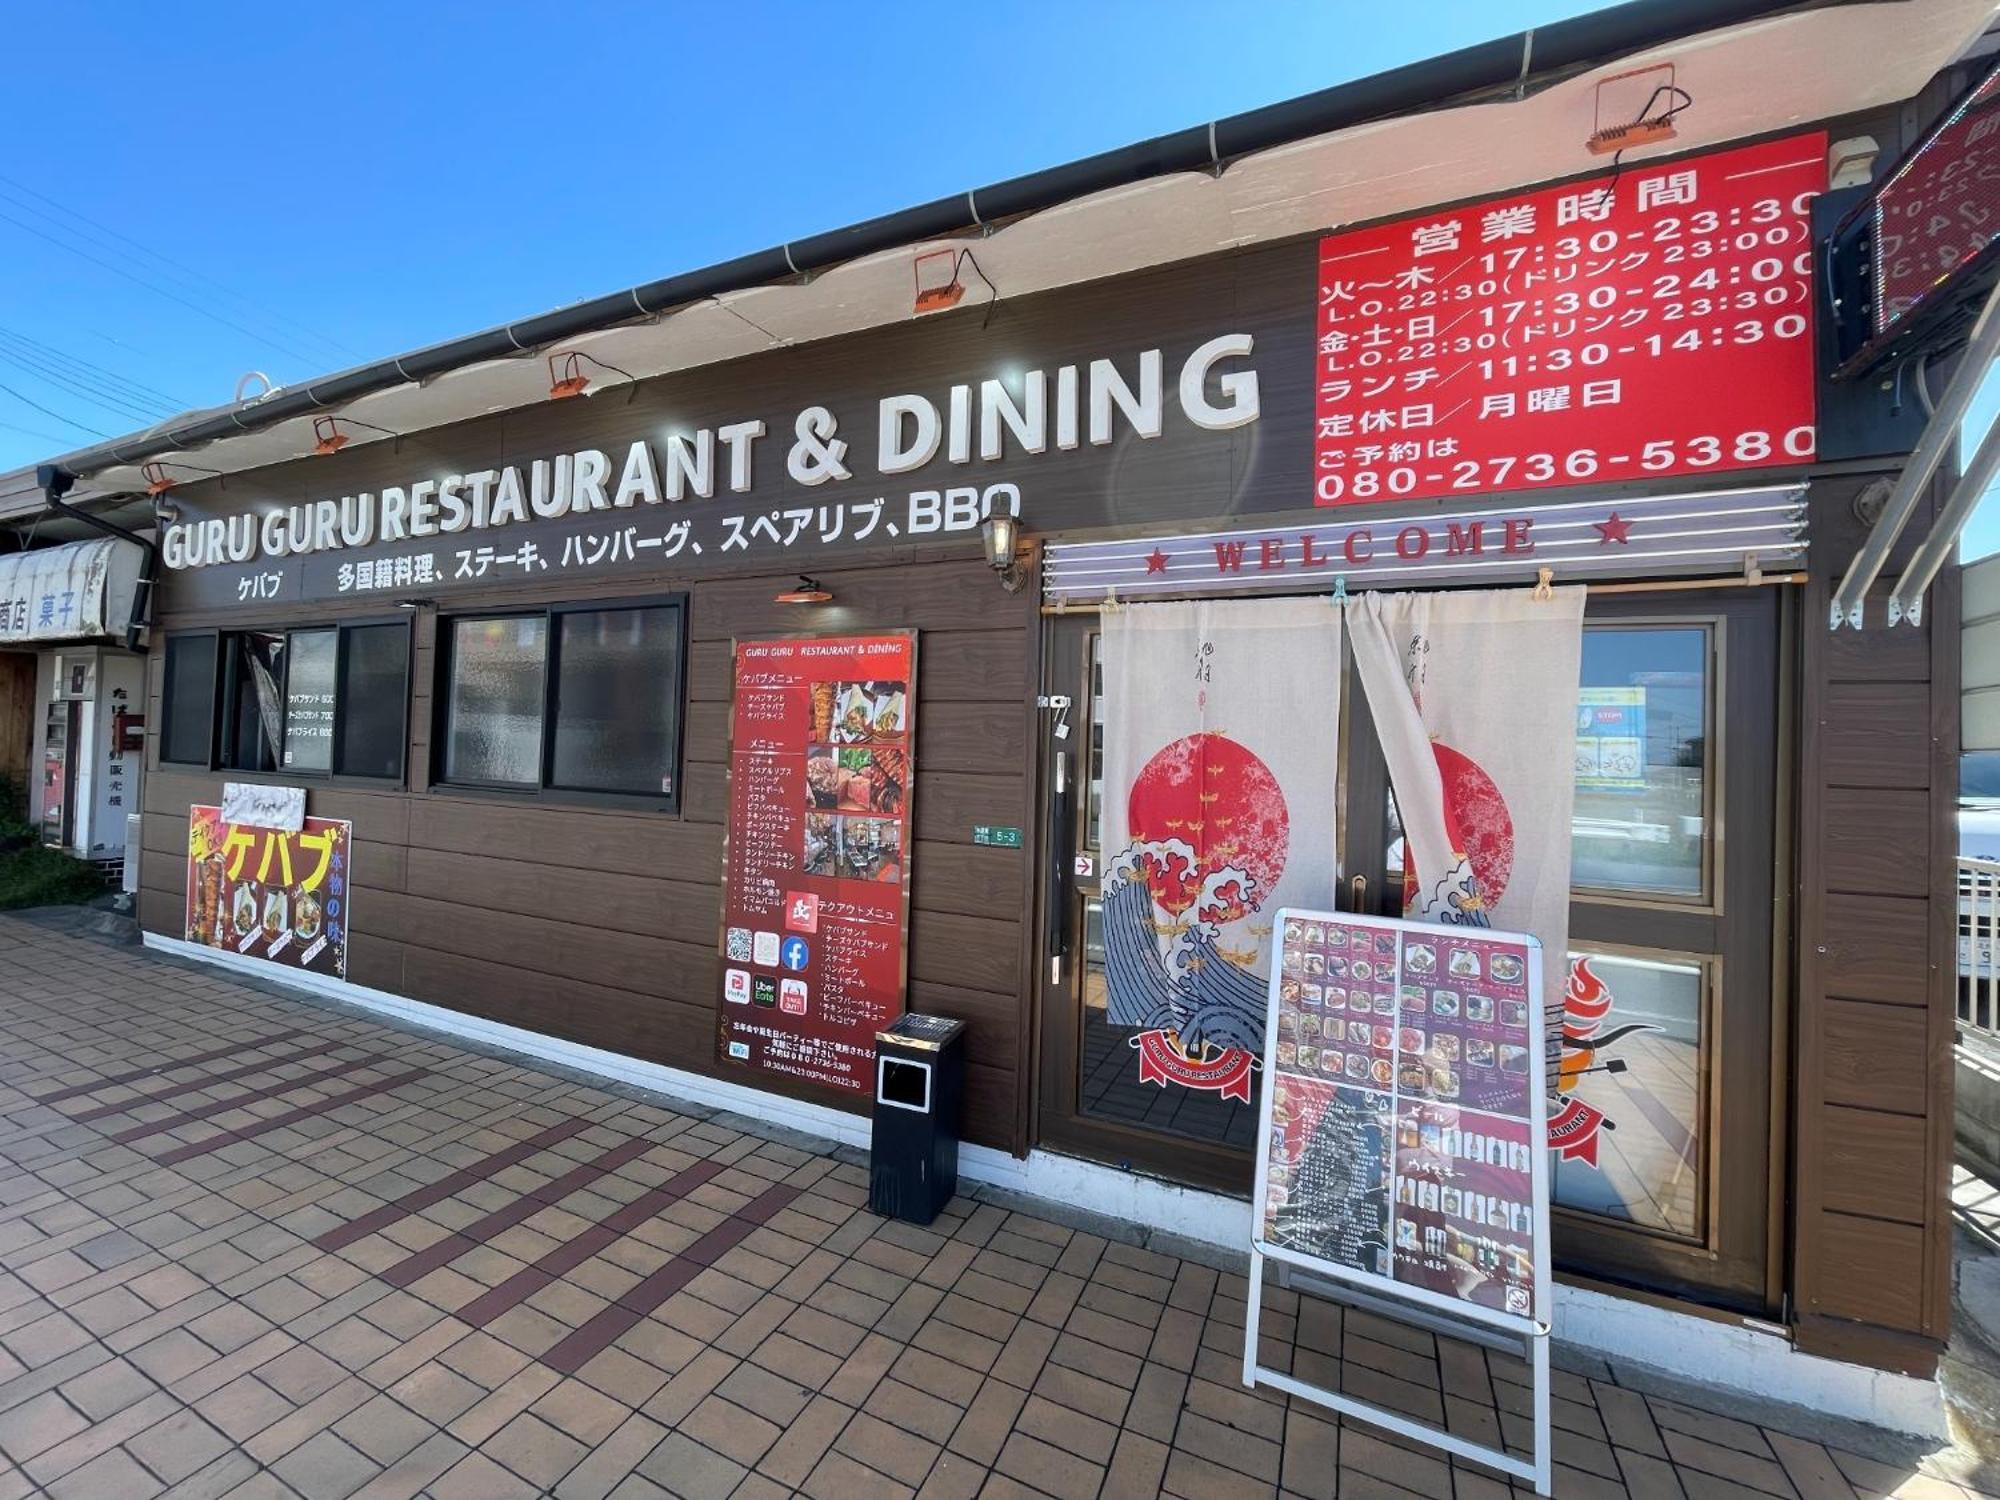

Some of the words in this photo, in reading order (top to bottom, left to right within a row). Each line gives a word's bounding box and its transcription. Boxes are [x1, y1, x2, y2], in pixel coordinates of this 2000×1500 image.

[1411, 169, 1699, 258] 営業時間
[162, 513, 258, 570] GURU
[261, 492, 375, 556] GURU
[380, 418, 767, 542] RESTAURANT
[786, 405, 853, 486] &
[877, 332, 1262, 475] DINING
[1317, 436, 1459, 469] ご予約は
[1317, 425, 1816, 500] 080-2736-5380
[1213, 518, 1536, 573] WELCOME
[237, 570, 284, 601] ケバブ
[750, 738, 785, 749] メニュー
[222, 824, 338, 894] ケバブ
[755, 980, 775, 992] Uber
